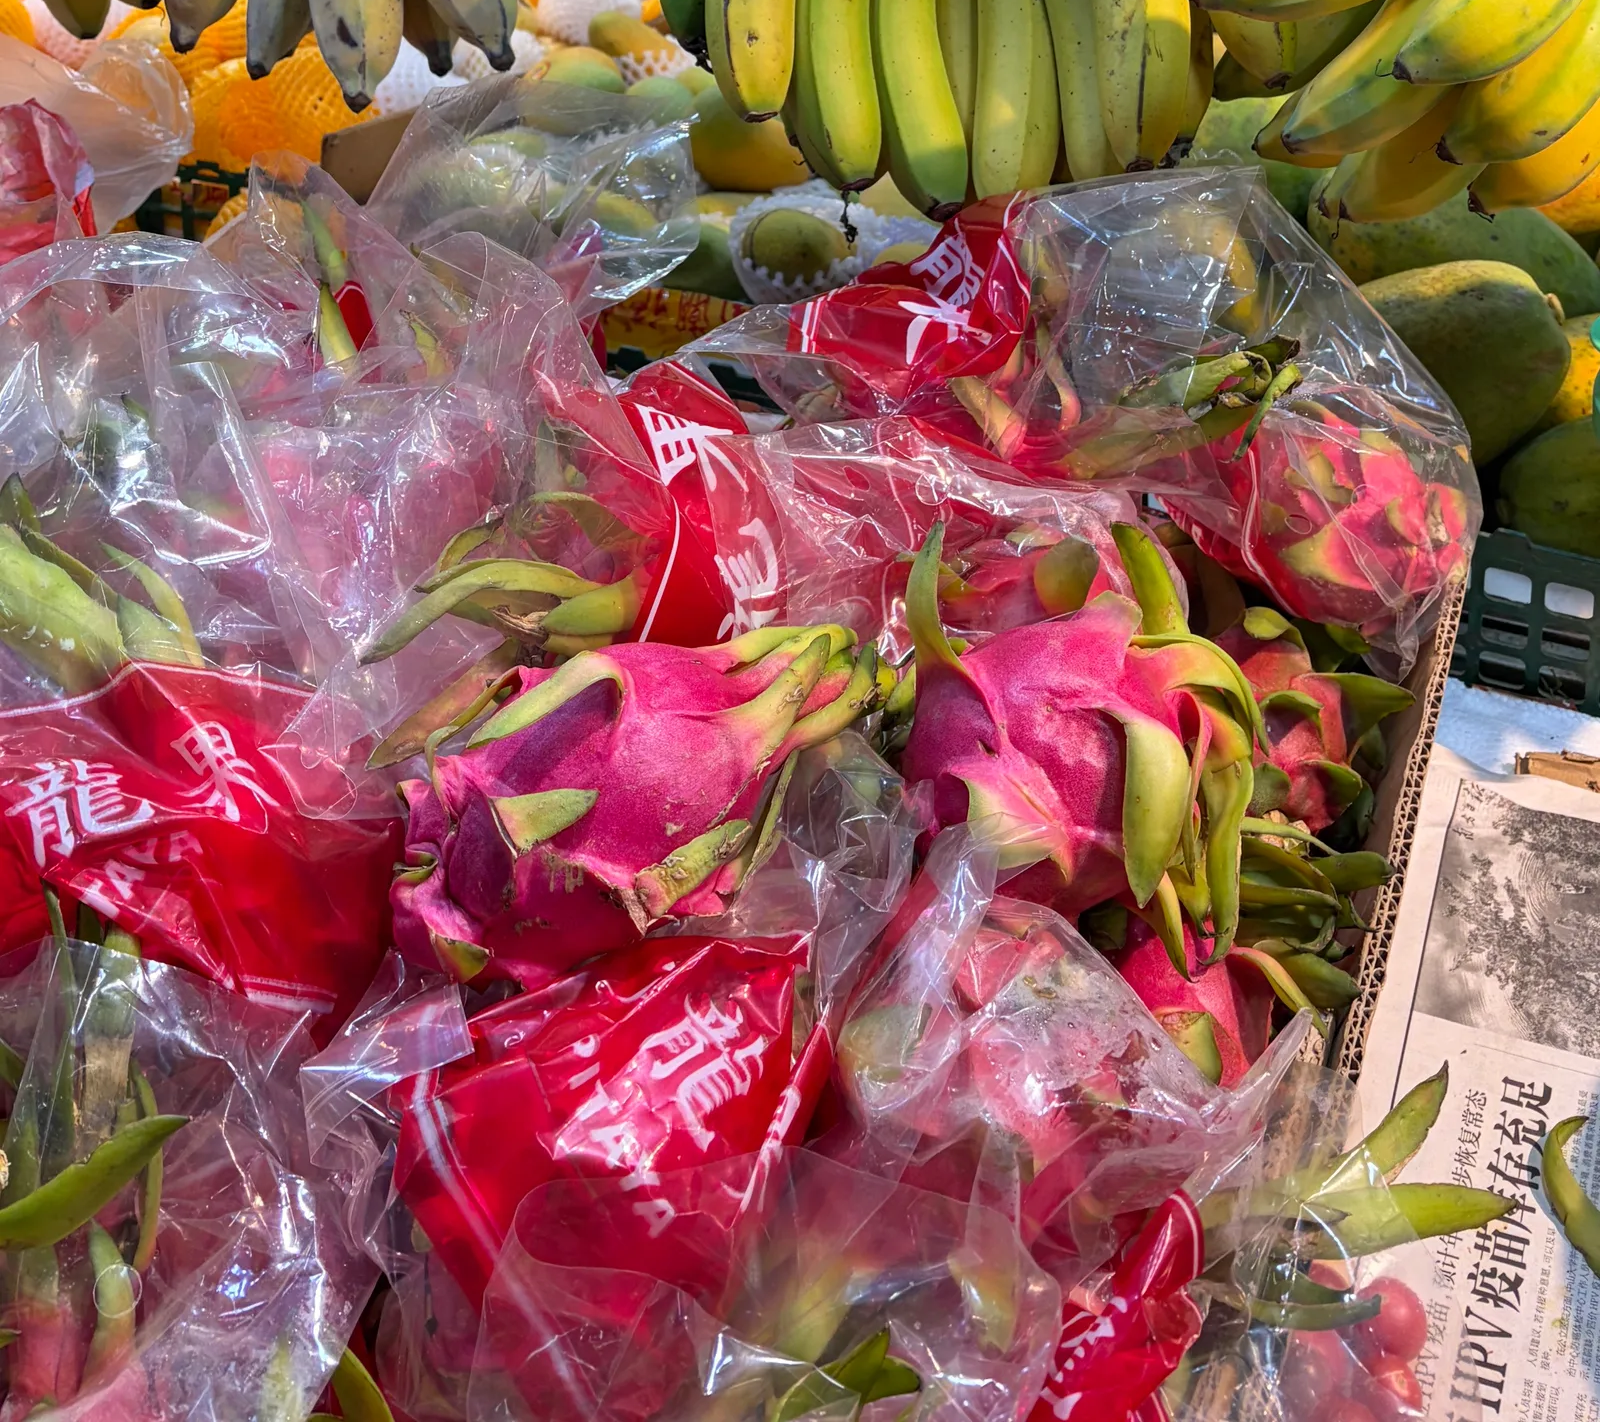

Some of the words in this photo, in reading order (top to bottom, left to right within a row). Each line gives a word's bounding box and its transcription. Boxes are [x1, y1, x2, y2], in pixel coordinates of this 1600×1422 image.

[1412, 1087, 1489, 1417] HPV疫苗，预计年步恢复常态
[1448, 1074, 1553, 1422] HPV疫苗库存充足
